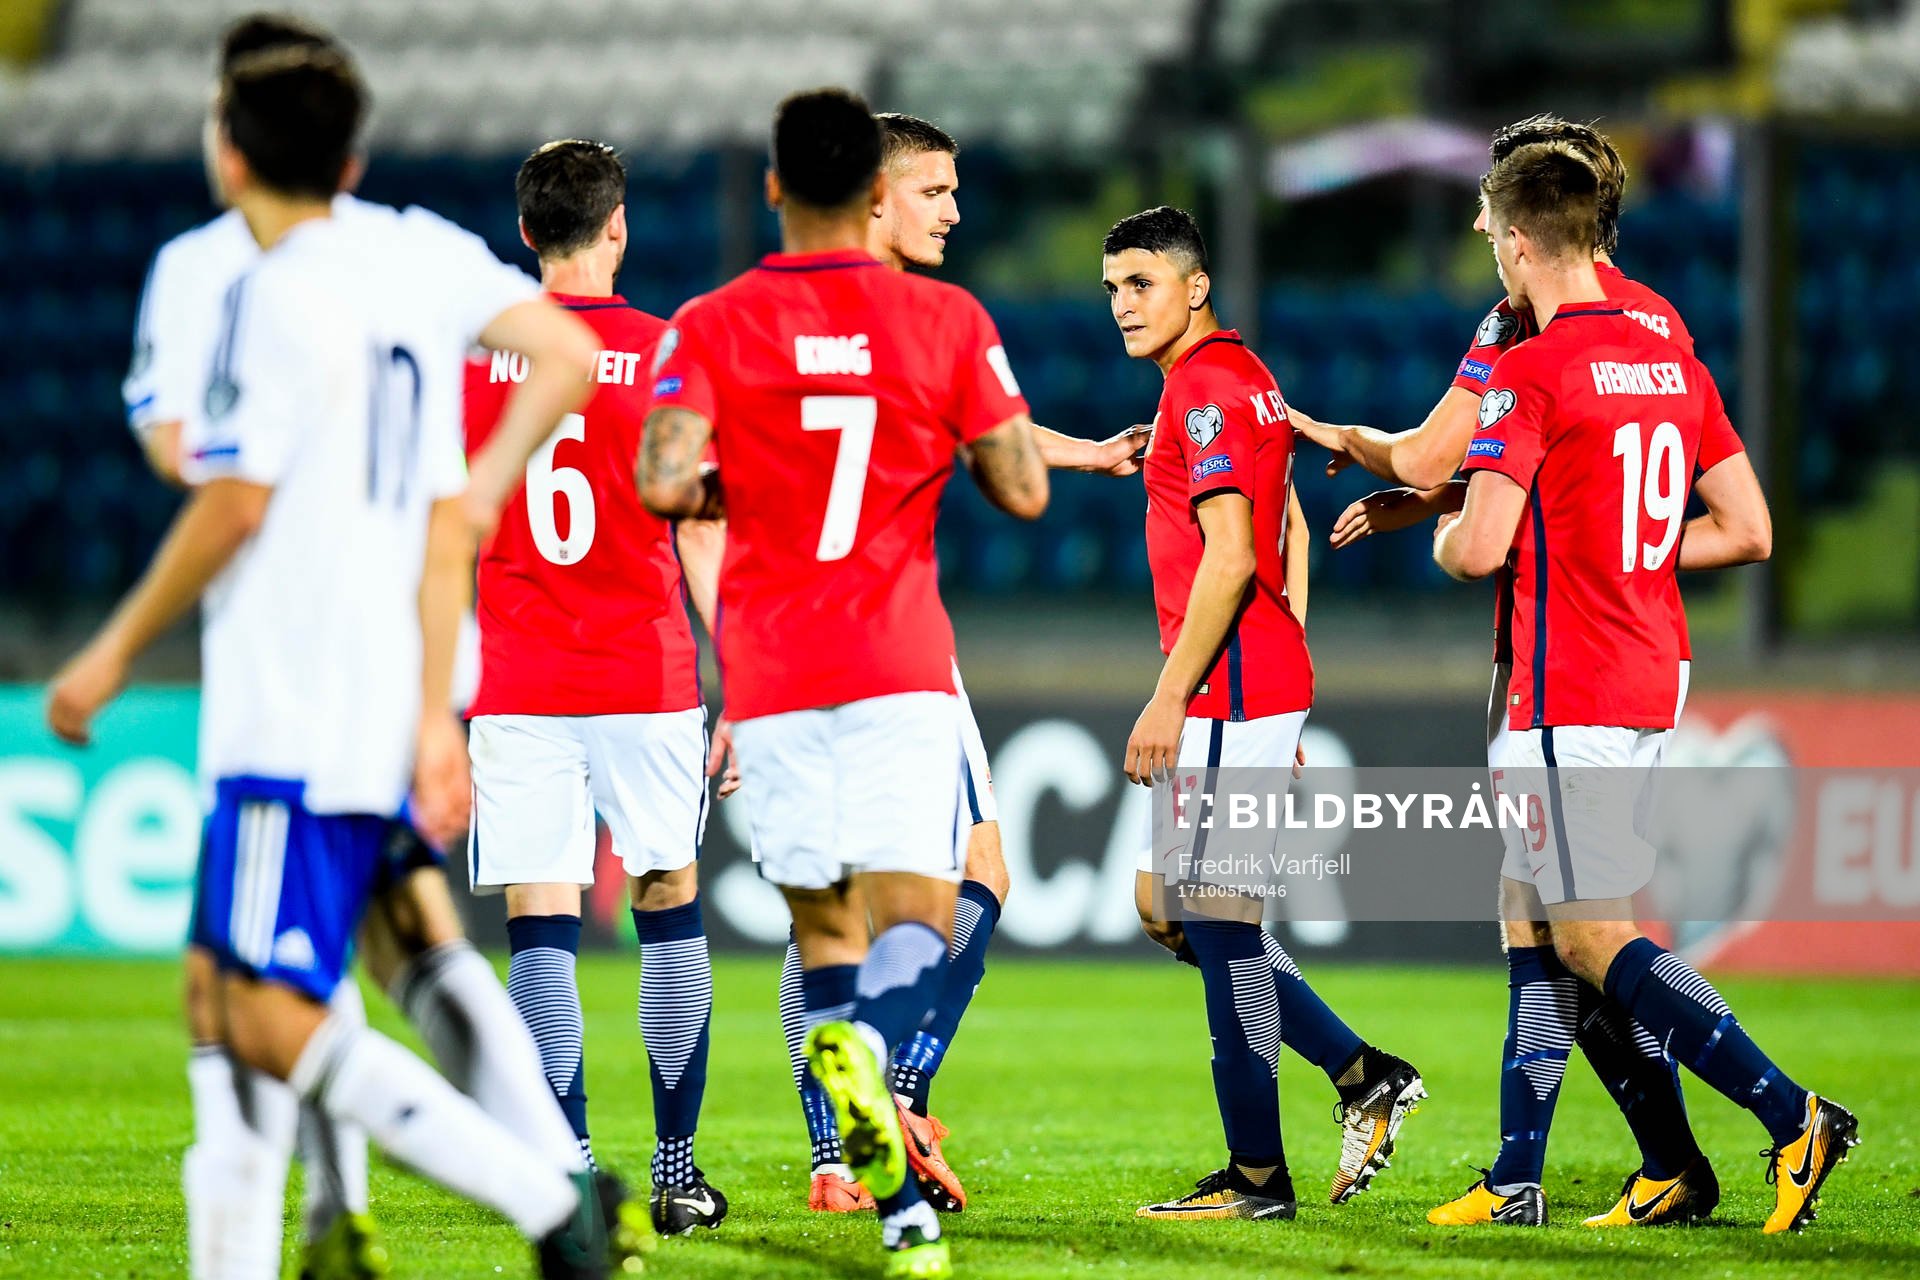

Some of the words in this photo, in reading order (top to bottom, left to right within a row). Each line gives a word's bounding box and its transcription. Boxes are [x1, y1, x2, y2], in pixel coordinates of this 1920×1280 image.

[793, 334, 873, 376] KING
[1590, 361, 1688, 396] HENRIKSEN
[525, 412, 597, 566] 6
[800, 395, 878, 562] 7
[1471, 442, 1505, 456] RESPECT
[1612, 421, 1687, 574] 19
